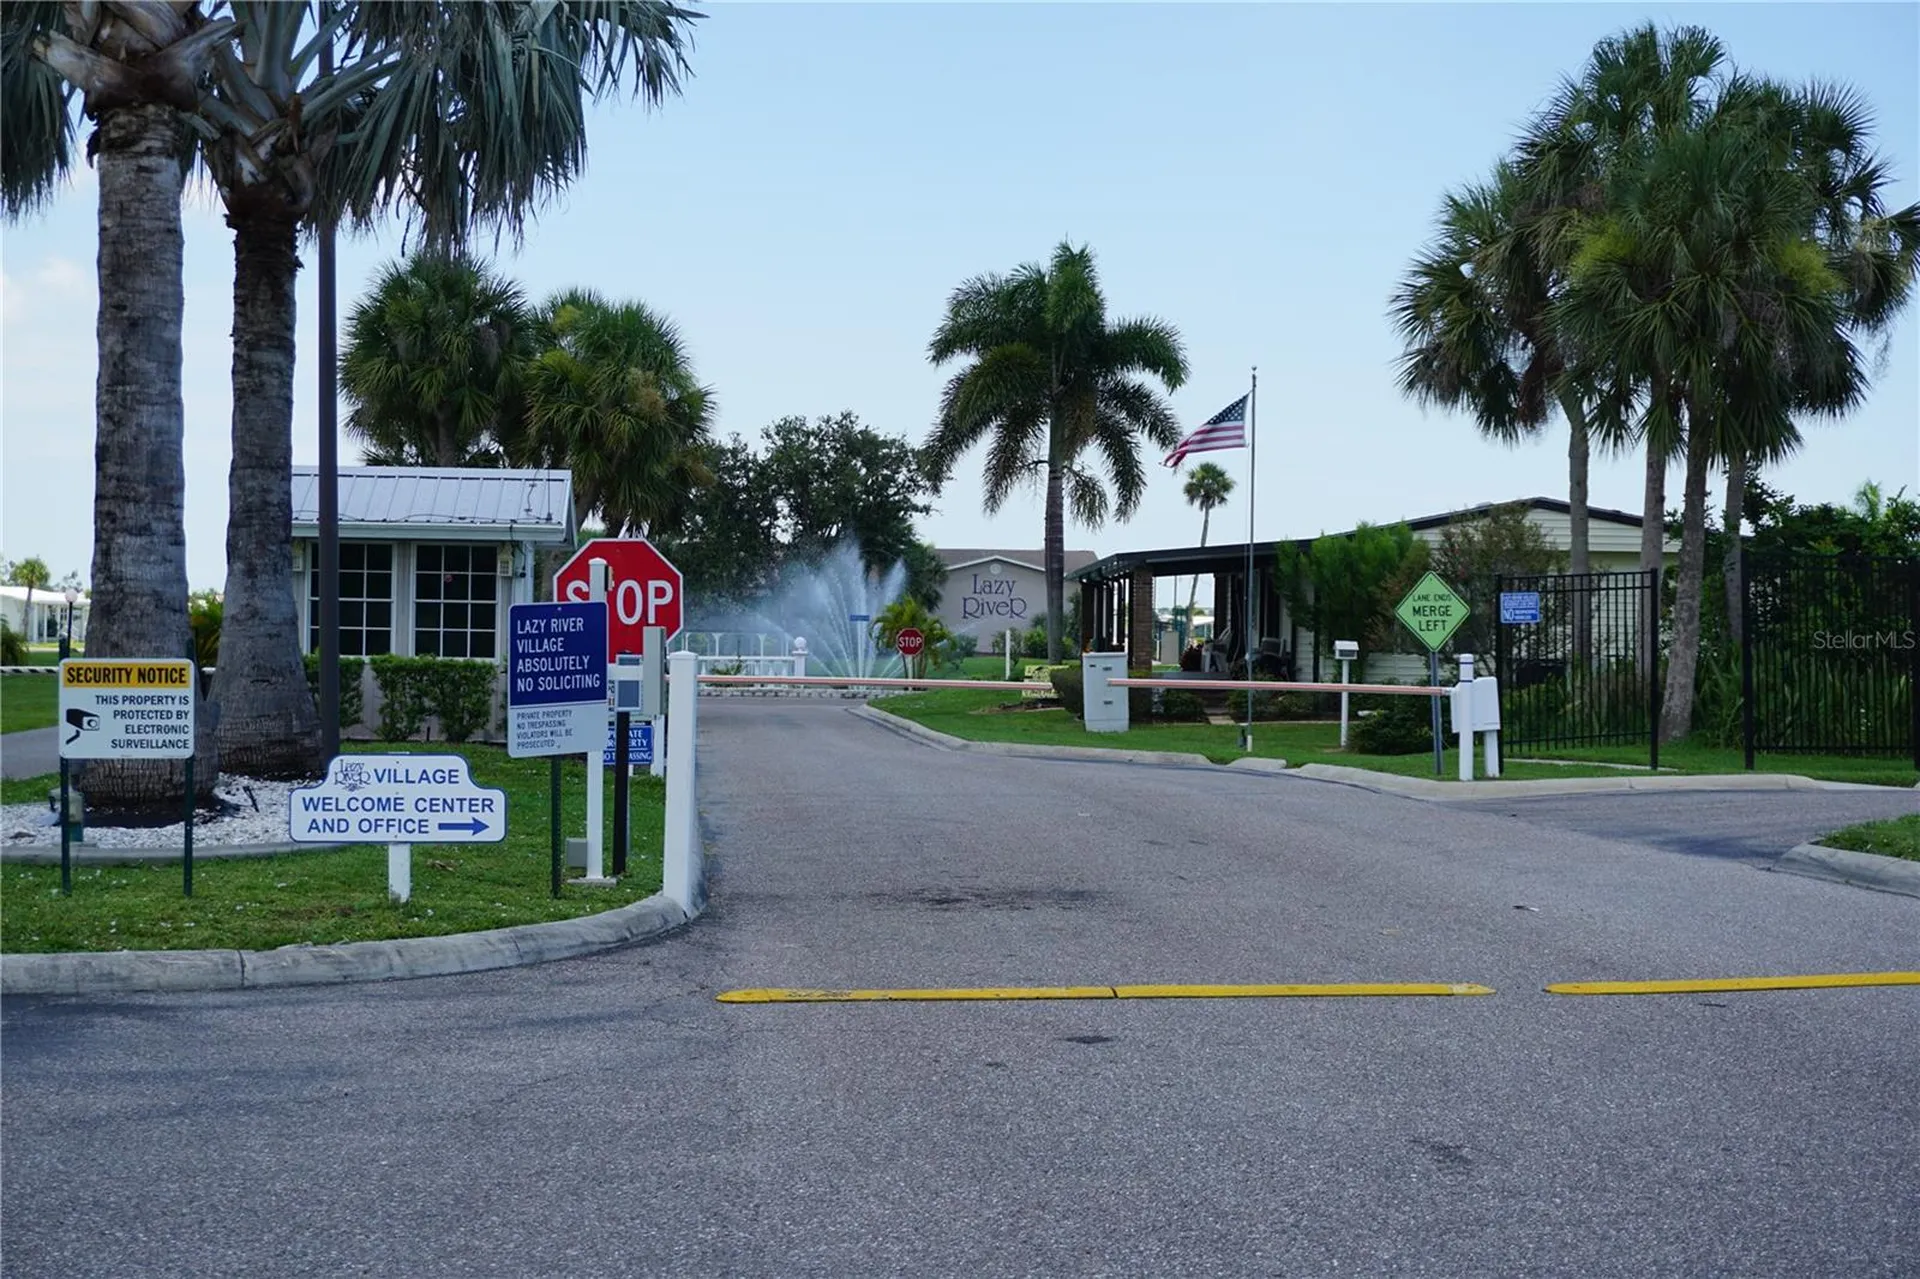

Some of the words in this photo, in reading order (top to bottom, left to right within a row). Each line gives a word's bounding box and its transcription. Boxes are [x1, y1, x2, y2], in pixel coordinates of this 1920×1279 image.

[972, 574, 1017, 597] Lazy
[1413, 594, 1431, 602] LANE
[1412, 605, 1453, 617] MERGE
[517, 619, 546, 634] LAZY
[551, 617, 584, 632] RIVER
[1419, 620, 1447, 632] LEFT
[517, 637, 564, 653] VILLAGE
[899, 636, 923, 648] STOP
[517, 655, 590, 673] ABSOLUTELY
[67, 667, 134, 684] SECURITY
[137, 667, 187, 684] NOTICE
[517, 677, 534, 692] NO
[538, 674, 600, 691] SOLICITING
[96, 695, 119, 705] THIS
[122, 695, 176, 705] PROPERTY
[179, 695, 190, 705] IS
[113, 710, 173, 720] PROTECTED
[176, 710, 190, 720] BY
[517, 711, 540, 721] PRIVATE
[542, 709, 573, 719] PROPERTY
[125, 724, 190, 735] ELECTRONIC
[517, 721, 526, 730] NO
[528, 719, 567, 729] TRESPASSING
[517, 731, 548, 740] VIOLATORS
[550, 729, 563, 738] WILL
[565, 728, 573, 737] BE
[111, 739, 190, 749] SURVEILLANCE
[517, 739, 556, 749] PROSECUTED
[374, 768, 460, 784] VILLAGE
[302, 797, 405, 812] WELCOME
[414, 798, 494, 813] CENTER
[307, 818, 350, 833] AND
[358, 819, 430, 834] OFFICE
